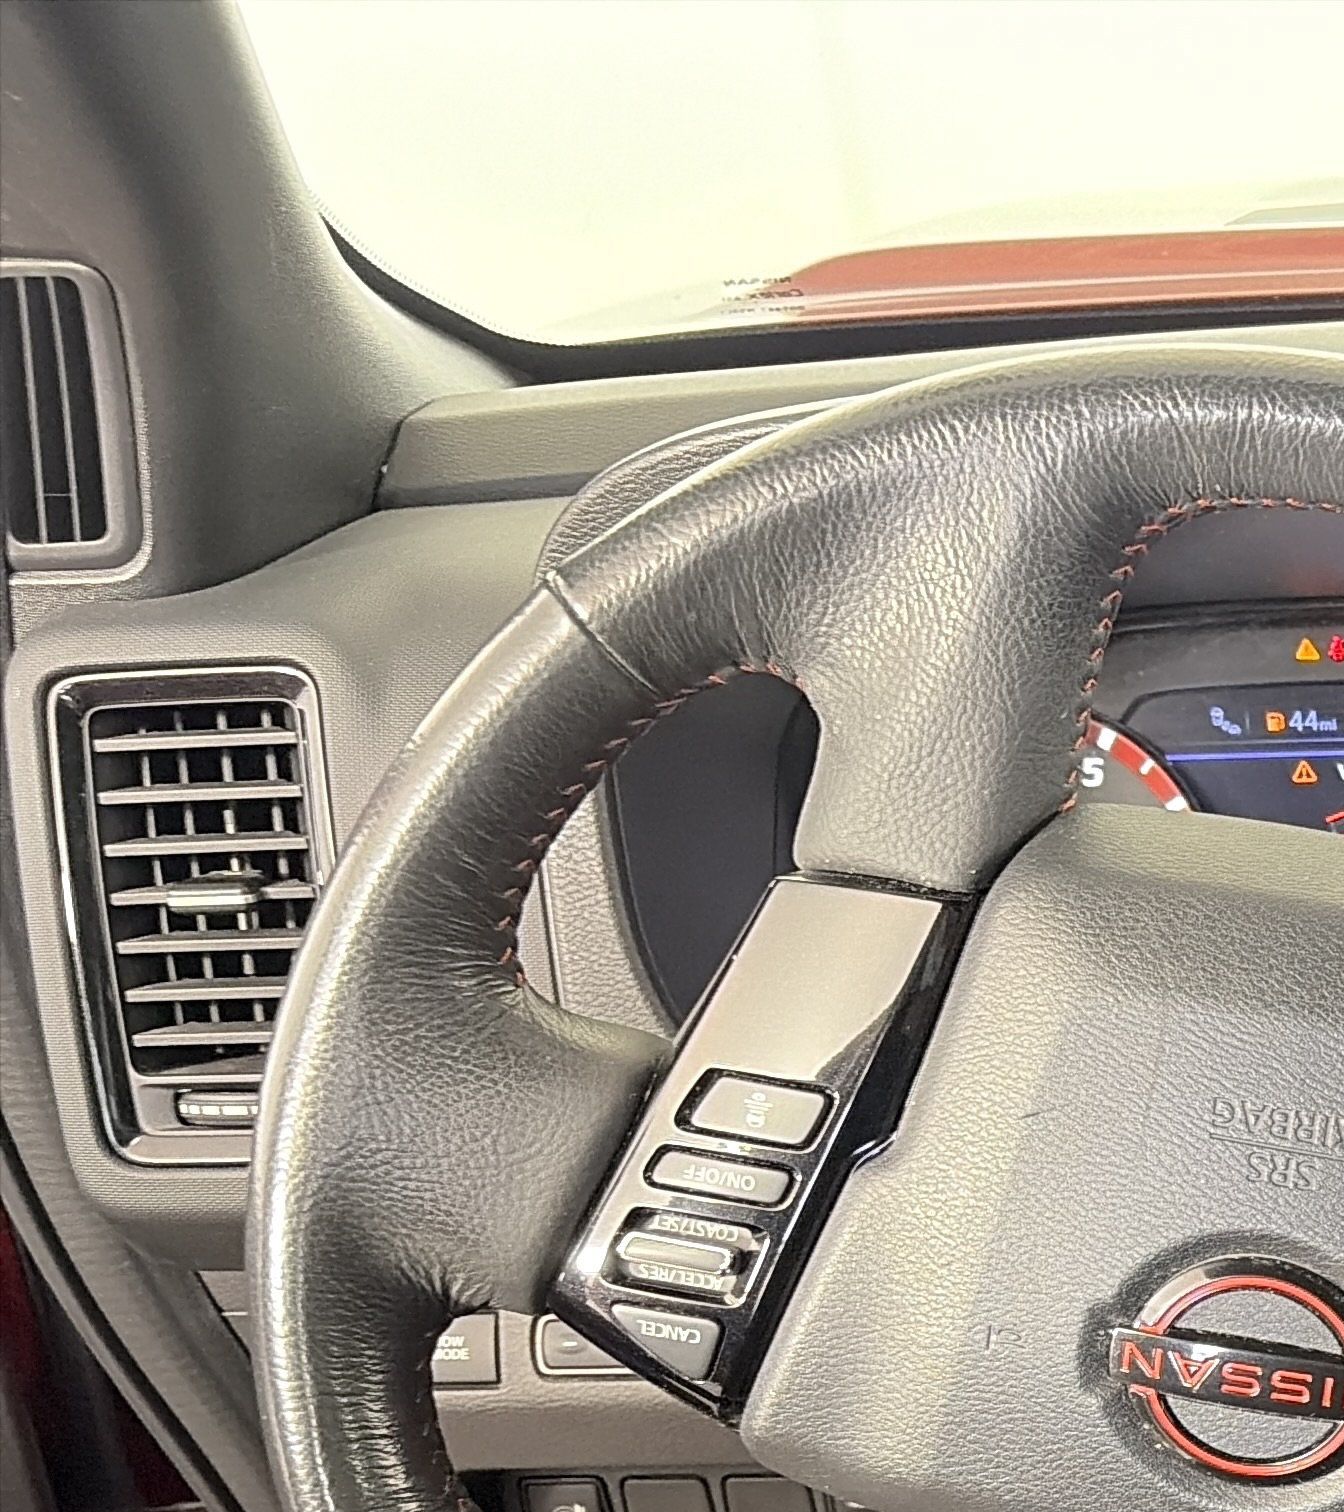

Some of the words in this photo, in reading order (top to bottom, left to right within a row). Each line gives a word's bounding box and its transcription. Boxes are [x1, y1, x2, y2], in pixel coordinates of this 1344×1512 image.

[1081, 757, 1105, 788] 5
[683, 1164, 756, 1191] ON/OFF
[1247, 1150, 1317, 1191] SRS
[651, 1214, 739, 1242] COAST/SET
[639, 1263, 725, 1291] ACCEL/RES
[636, 1319, 701, 1345] CANCEL
